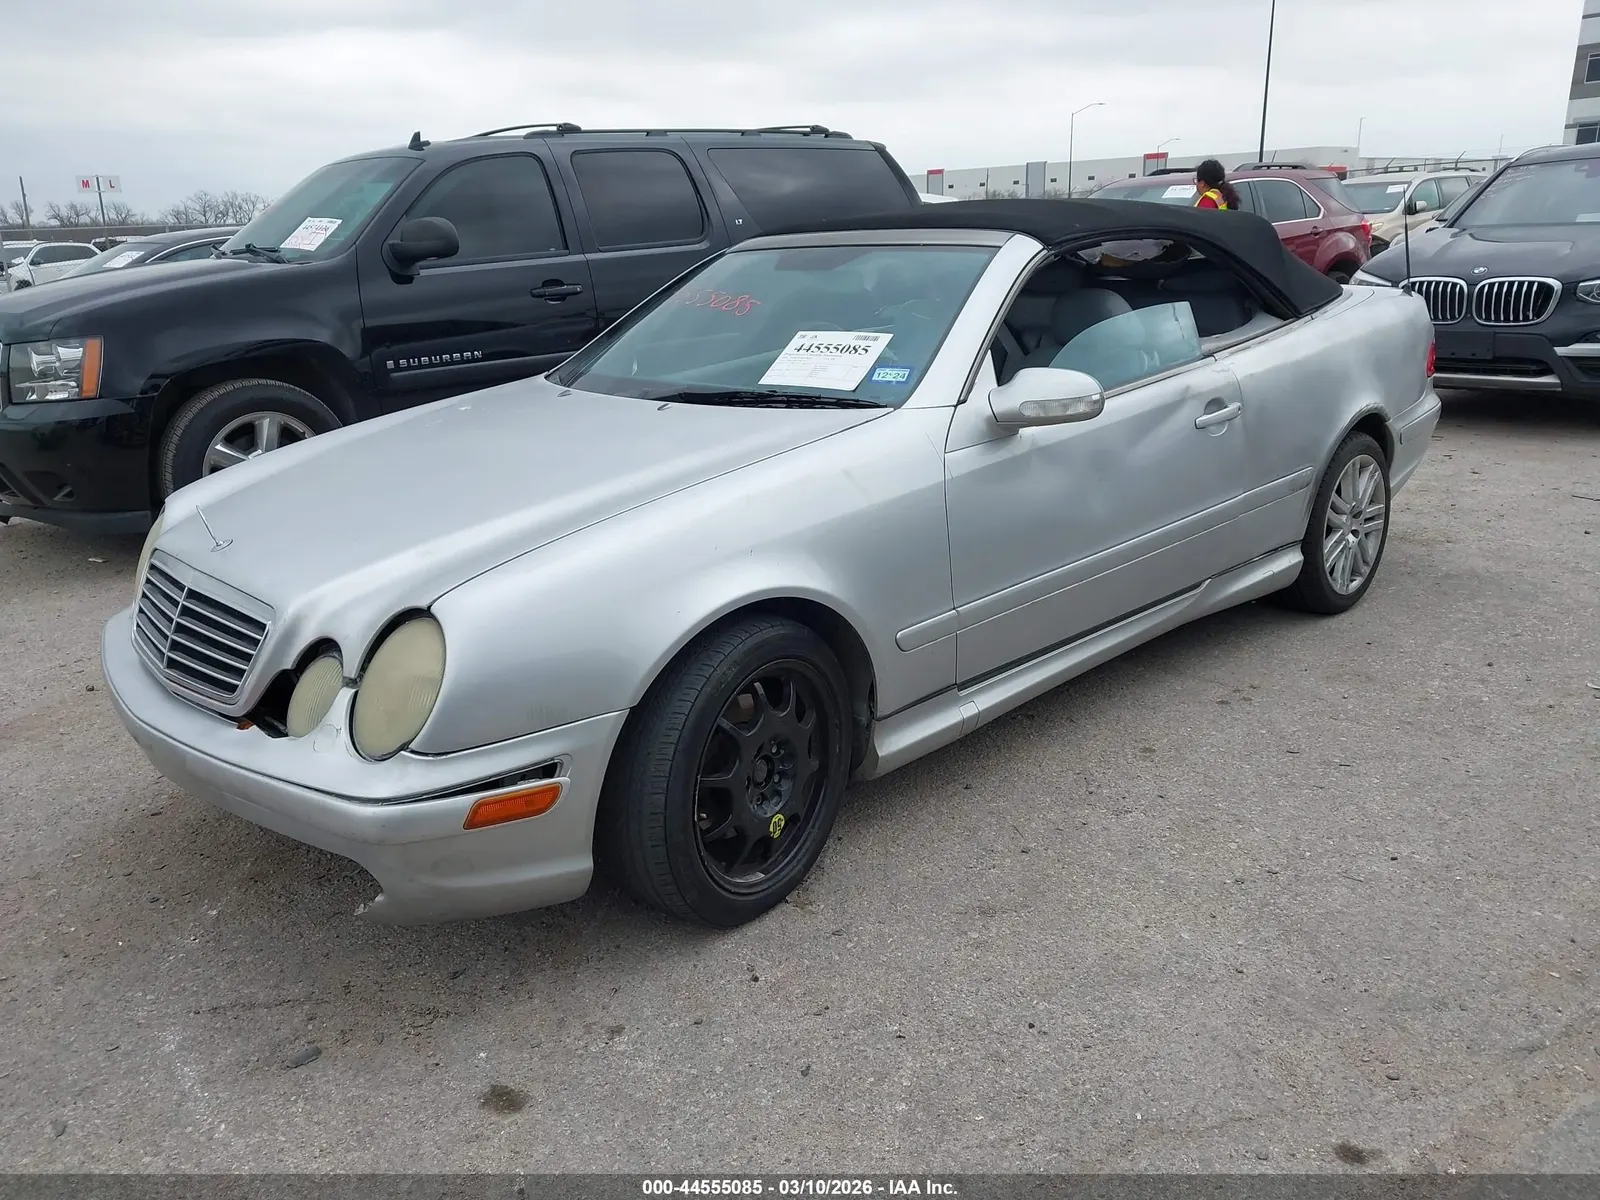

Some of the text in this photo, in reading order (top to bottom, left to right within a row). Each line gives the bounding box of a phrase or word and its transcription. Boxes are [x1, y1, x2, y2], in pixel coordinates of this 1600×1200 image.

[81, 179, 90, 189] M
[108, 179, 115, 189] L
[793, 341, 873, 356] 44555085
[399, 350, 483, 368] SUBURBAN
